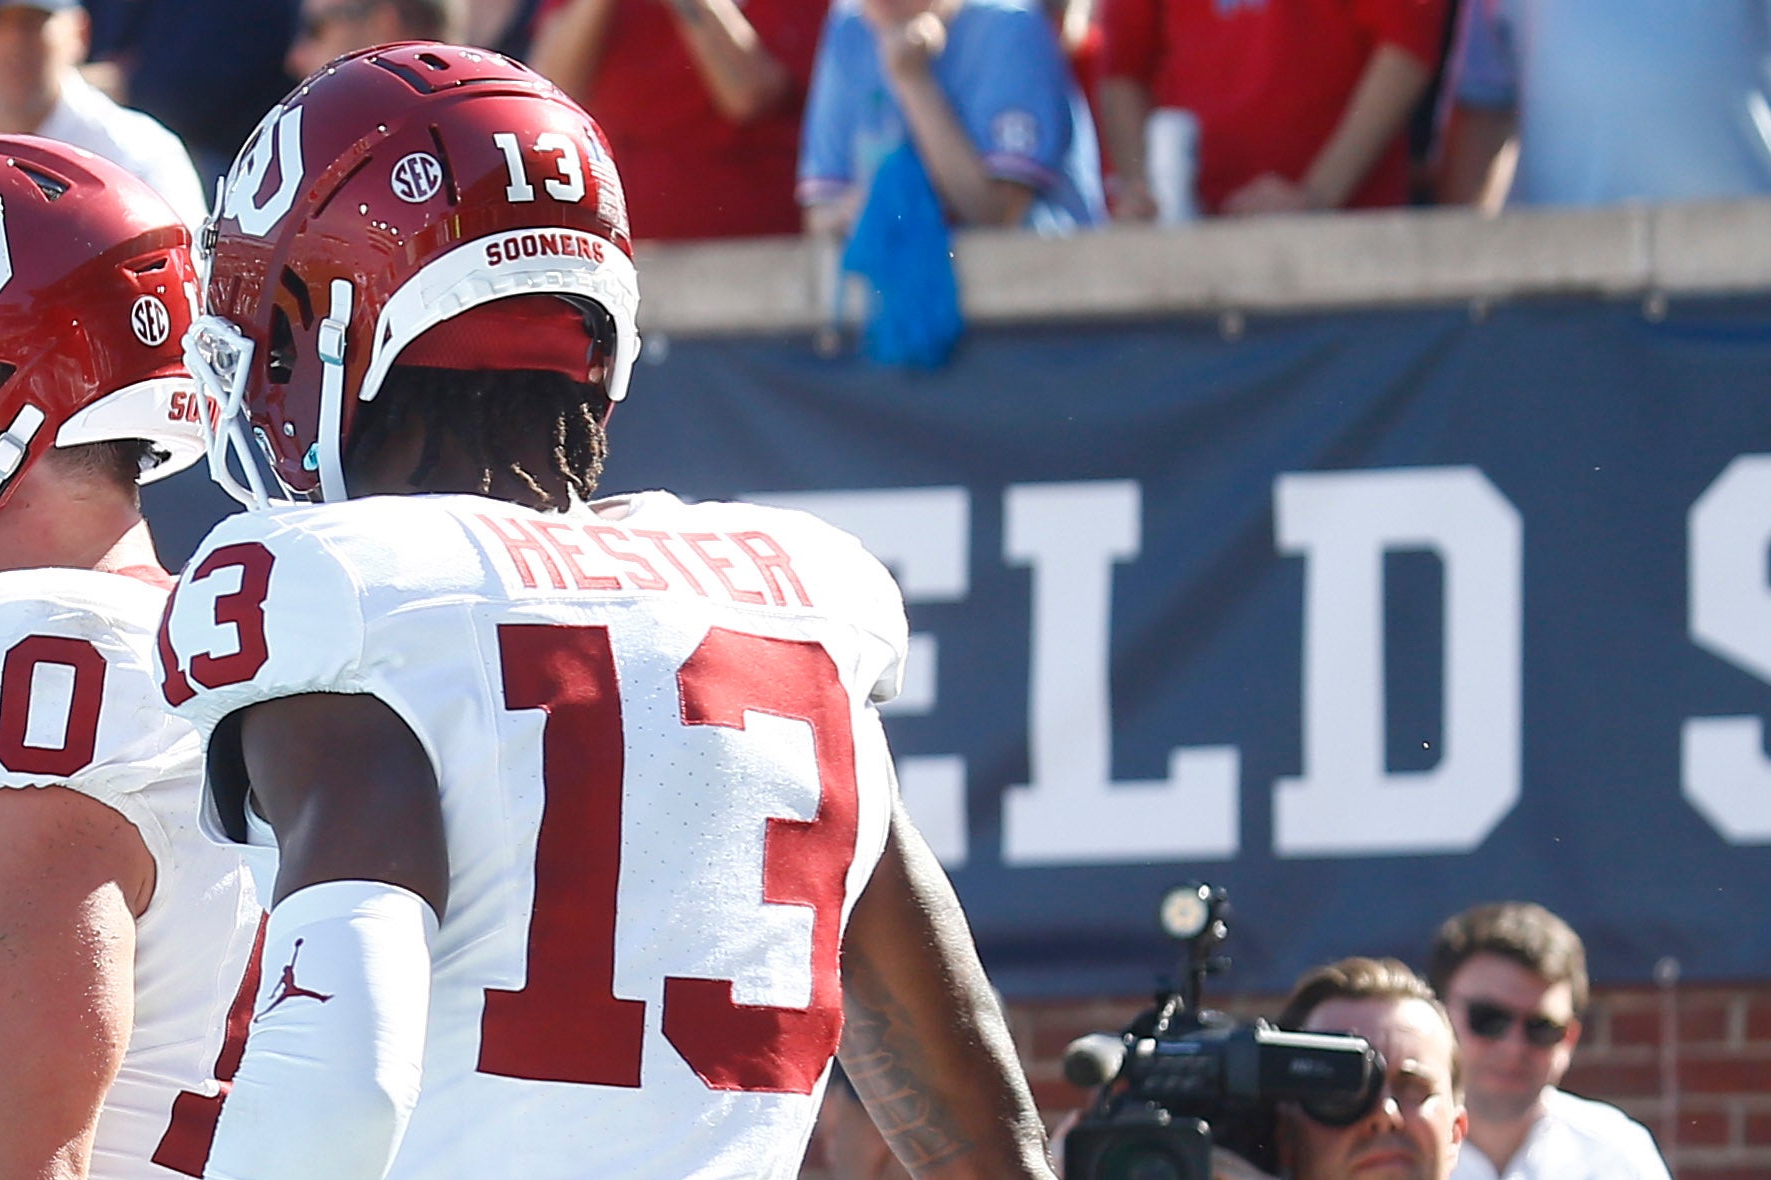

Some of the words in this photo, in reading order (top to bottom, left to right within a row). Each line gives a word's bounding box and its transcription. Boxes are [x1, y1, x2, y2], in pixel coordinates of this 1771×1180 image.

[393, 154, 442, 202] SEC
[492, 132, 586, 203] 13
[485, 233, 605, 267] SOONERS
[132, 297, 169, 345] SEC
[474, 513, 814, 608] HESTER
[476, 623, 860, 1095] 13
